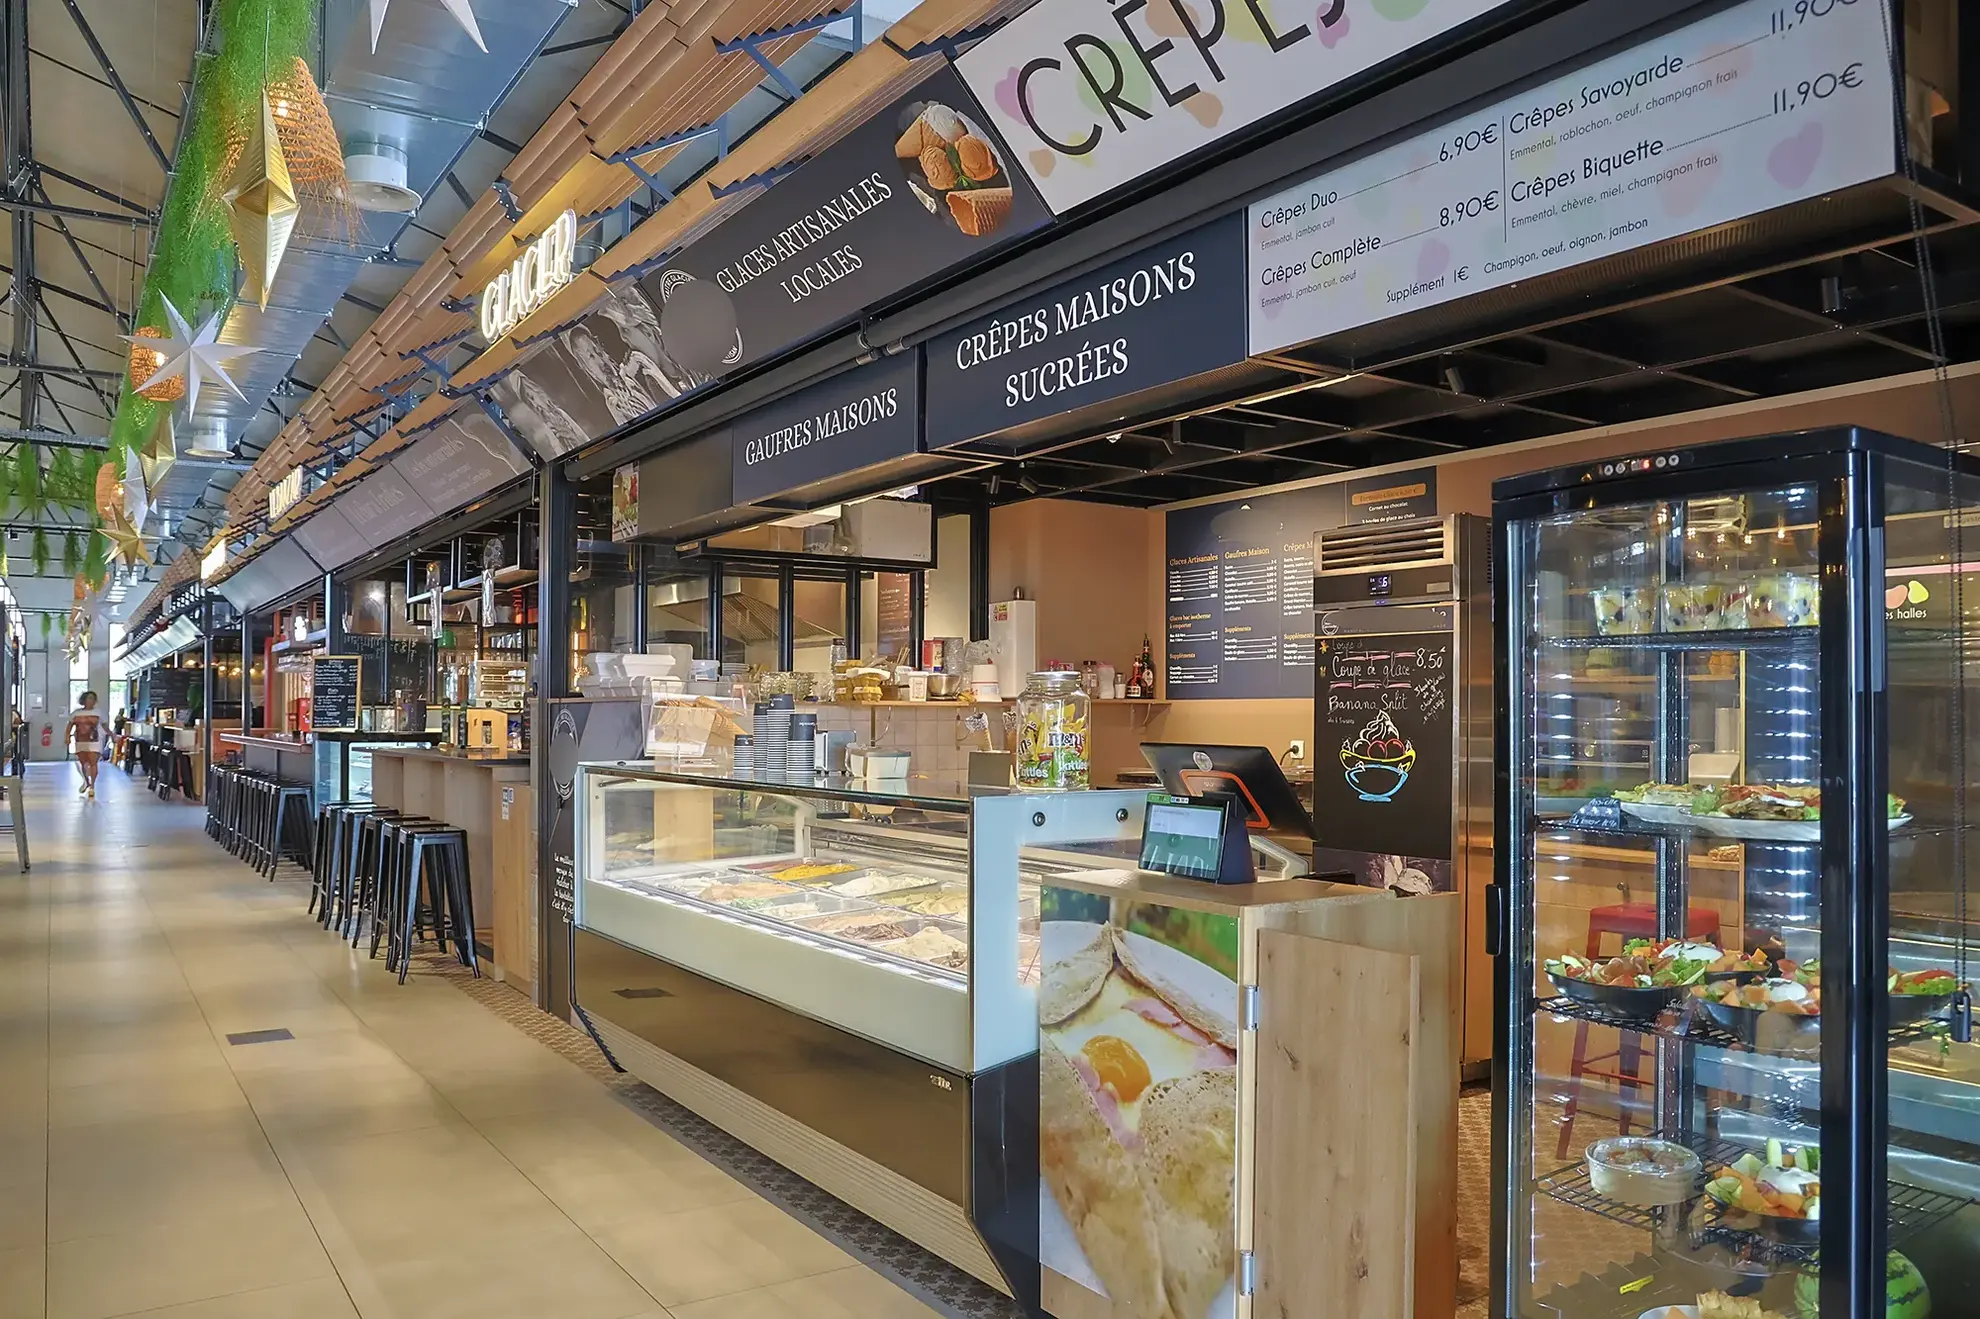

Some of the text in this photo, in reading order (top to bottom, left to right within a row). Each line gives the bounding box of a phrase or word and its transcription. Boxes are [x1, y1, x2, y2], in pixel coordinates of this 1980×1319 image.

[1509, 99, 1575, 135] Crêpes
[1580, 54, 1684, 108] Savoyarde
[1510, 67, 1738, 161] Emmental, roblochon, oeuf, champignon frais
[1511, 62, 1864, 203] Crêpes Biquette 11,90€
[1261, 123, 1498, 229] Crêpes Duo 6,90€
[1511, 153, 1719, 229] Emmental, chèvre, miel, champignon frais
[716, 172, 892, 293] GLACES ARTISANALES
[1261, 216, 1335, 250] Emmental, jambon cuit
[1261, 190, 1499, 286] Crêpes Complète 8,90€
[1386, 218, 1649, 304] Supplément 1€ Champigon, oeuf, oignon, jambon
[780, 244, 863, 303] LOCALES
[956, 251, 1196, 371] CRÊPES MAISONS
[1261, 291, 1294, 308] Emmental,
[1295, 282, 1322, 298] jambon
[1339, 270, 1357, 284] oeuf
[1005, 338, 1128, 408] SUCRÉES
[745, 388, 897, 466] GAUFRES MAISONS
[1248, 547, 1270, 556] Maison
[1897, 607, 1927, 620] halles
[1328, 690, 1409, 715] Banana Split
